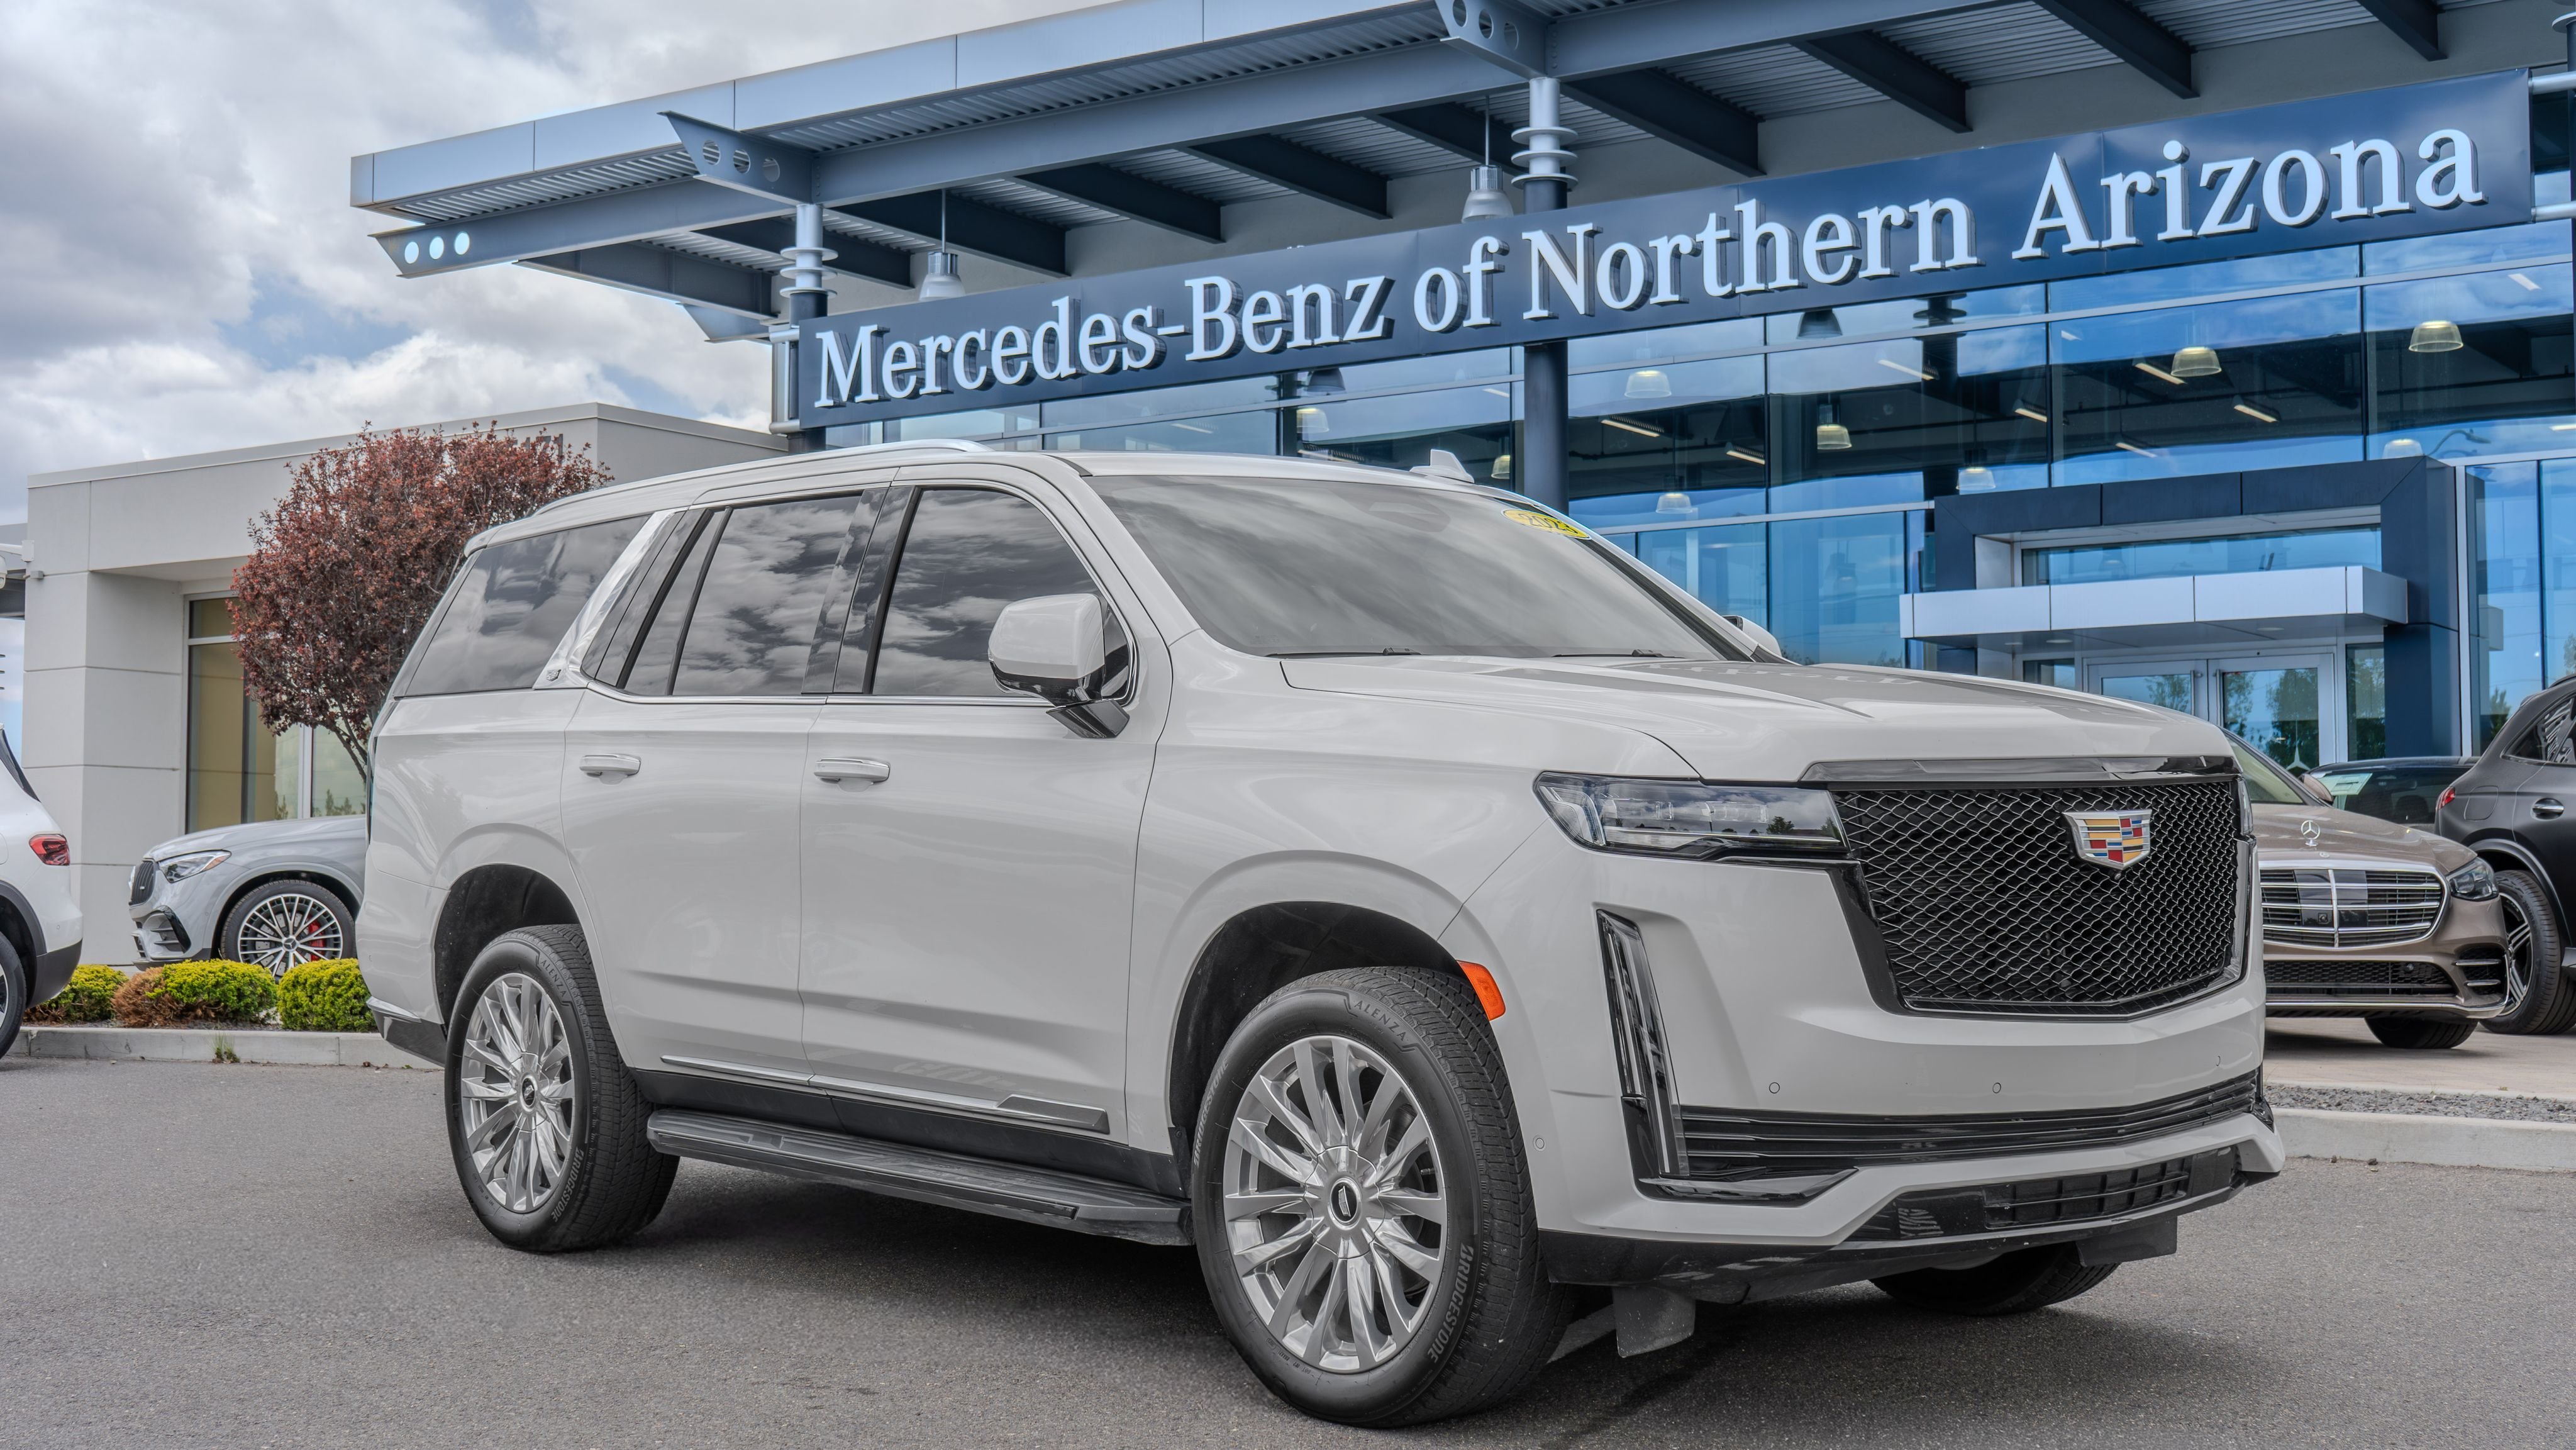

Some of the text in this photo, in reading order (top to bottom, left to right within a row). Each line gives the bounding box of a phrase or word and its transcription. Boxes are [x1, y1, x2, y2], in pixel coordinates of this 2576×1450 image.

[814, 128, 2487, 408] Mercedes-Benz of Northern Arizona
[540, 959, 567, 998] ALENZA
[1354, 1000, 1407, 1042] ALENZA
[1193, 1059, 1229, 1168] BRIDGESTONE
[550, 1146, 585, 1223] BRIDGESTONE
[1427, 1242, 1475, 1364] BRIDGESTONE
